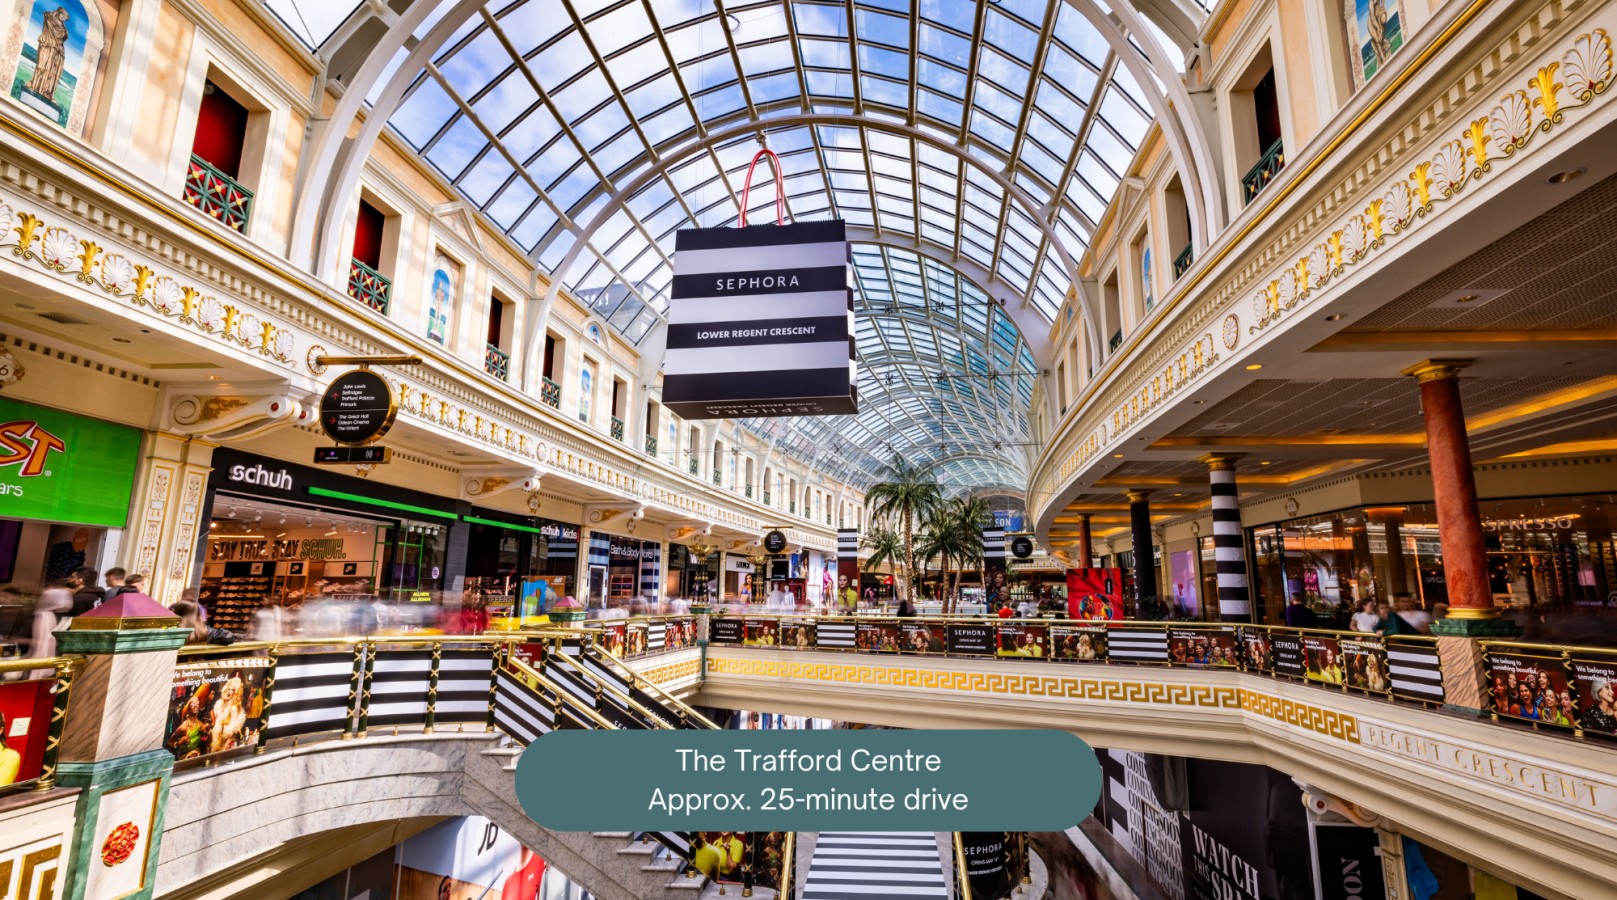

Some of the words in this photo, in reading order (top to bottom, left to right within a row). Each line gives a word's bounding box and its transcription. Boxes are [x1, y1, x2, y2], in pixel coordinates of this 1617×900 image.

[716, 275, 800, 291] SEPHORA
[697, 330, 730, 340] LOWER
[732, 328, 768, 338] REGENT
[770, 326, 816, 336] CRESCENT
[229, 464, 293, 490] schuh
[1483, 516, 1573, 532] SPRESSO
[540, 525, 560, 538] schuh
[562, 526, 578, 540] kids
[211, 541, 239, 561] STAY
[271, 539, 300, 559] STAY
[300, 538, 347, 560] SCHUH.
[1275, 640, 1300, 650] SEPHORA
[1492, 664, 1515, 673] something
[1500, 658, 1515, 666] belong
[182, 668, 204, 678] belong
[1577, 674, 1607, 683] something
[1586, 667, 1607, 676] belong
[171, 679, 201, 687] omething
[1454, 749, 1598, 807] CRESCENT
[477, 821, 499, 856] JD
[964, 842, 1003, 855] SEPHORA
[1192, 824, 1259, 900] WATCH
[1193, 854, 1210, 883] THIS
[1341, 857, 1363, 900] ON
